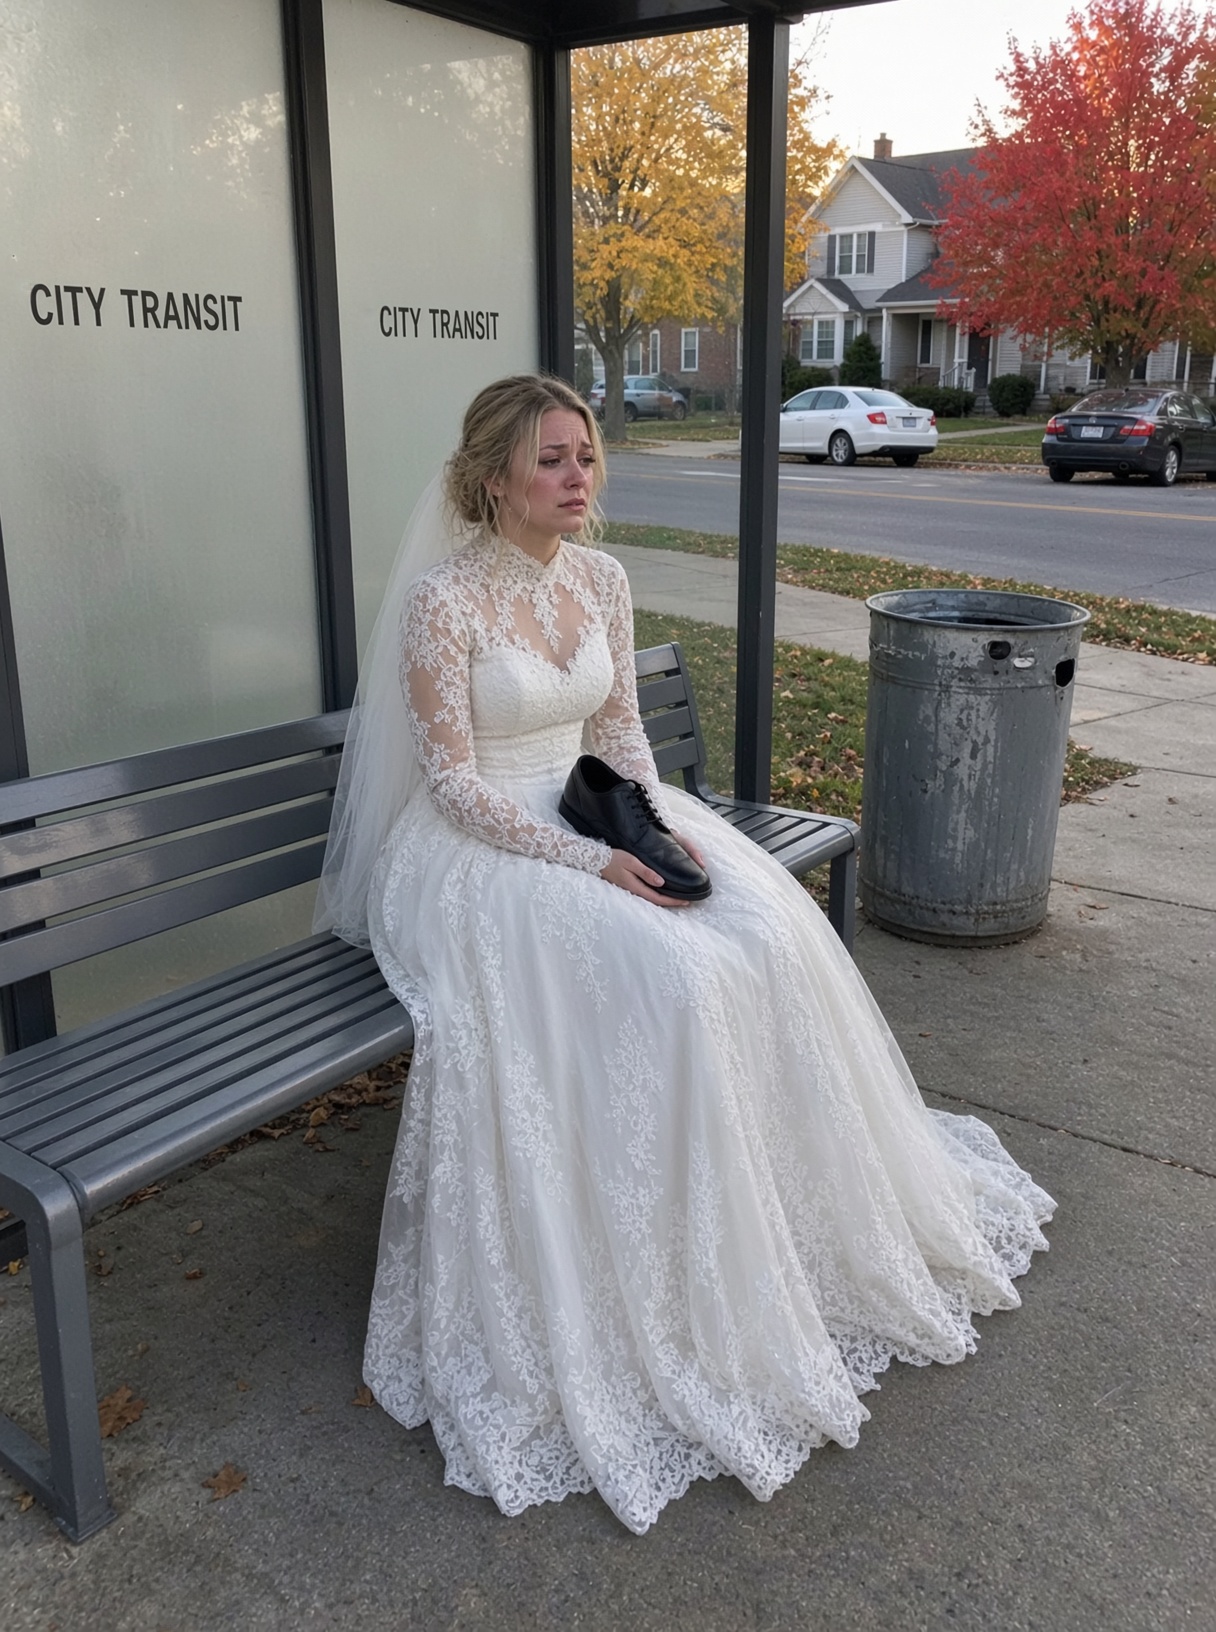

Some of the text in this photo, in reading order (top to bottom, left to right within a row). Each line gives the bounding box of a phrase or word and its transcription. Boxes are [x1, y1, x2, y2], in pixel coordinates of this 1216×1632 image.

[30, 284, 242, 331] CITY TRANSIT
[380, 305, 499, 340] CITY TRANSIT
